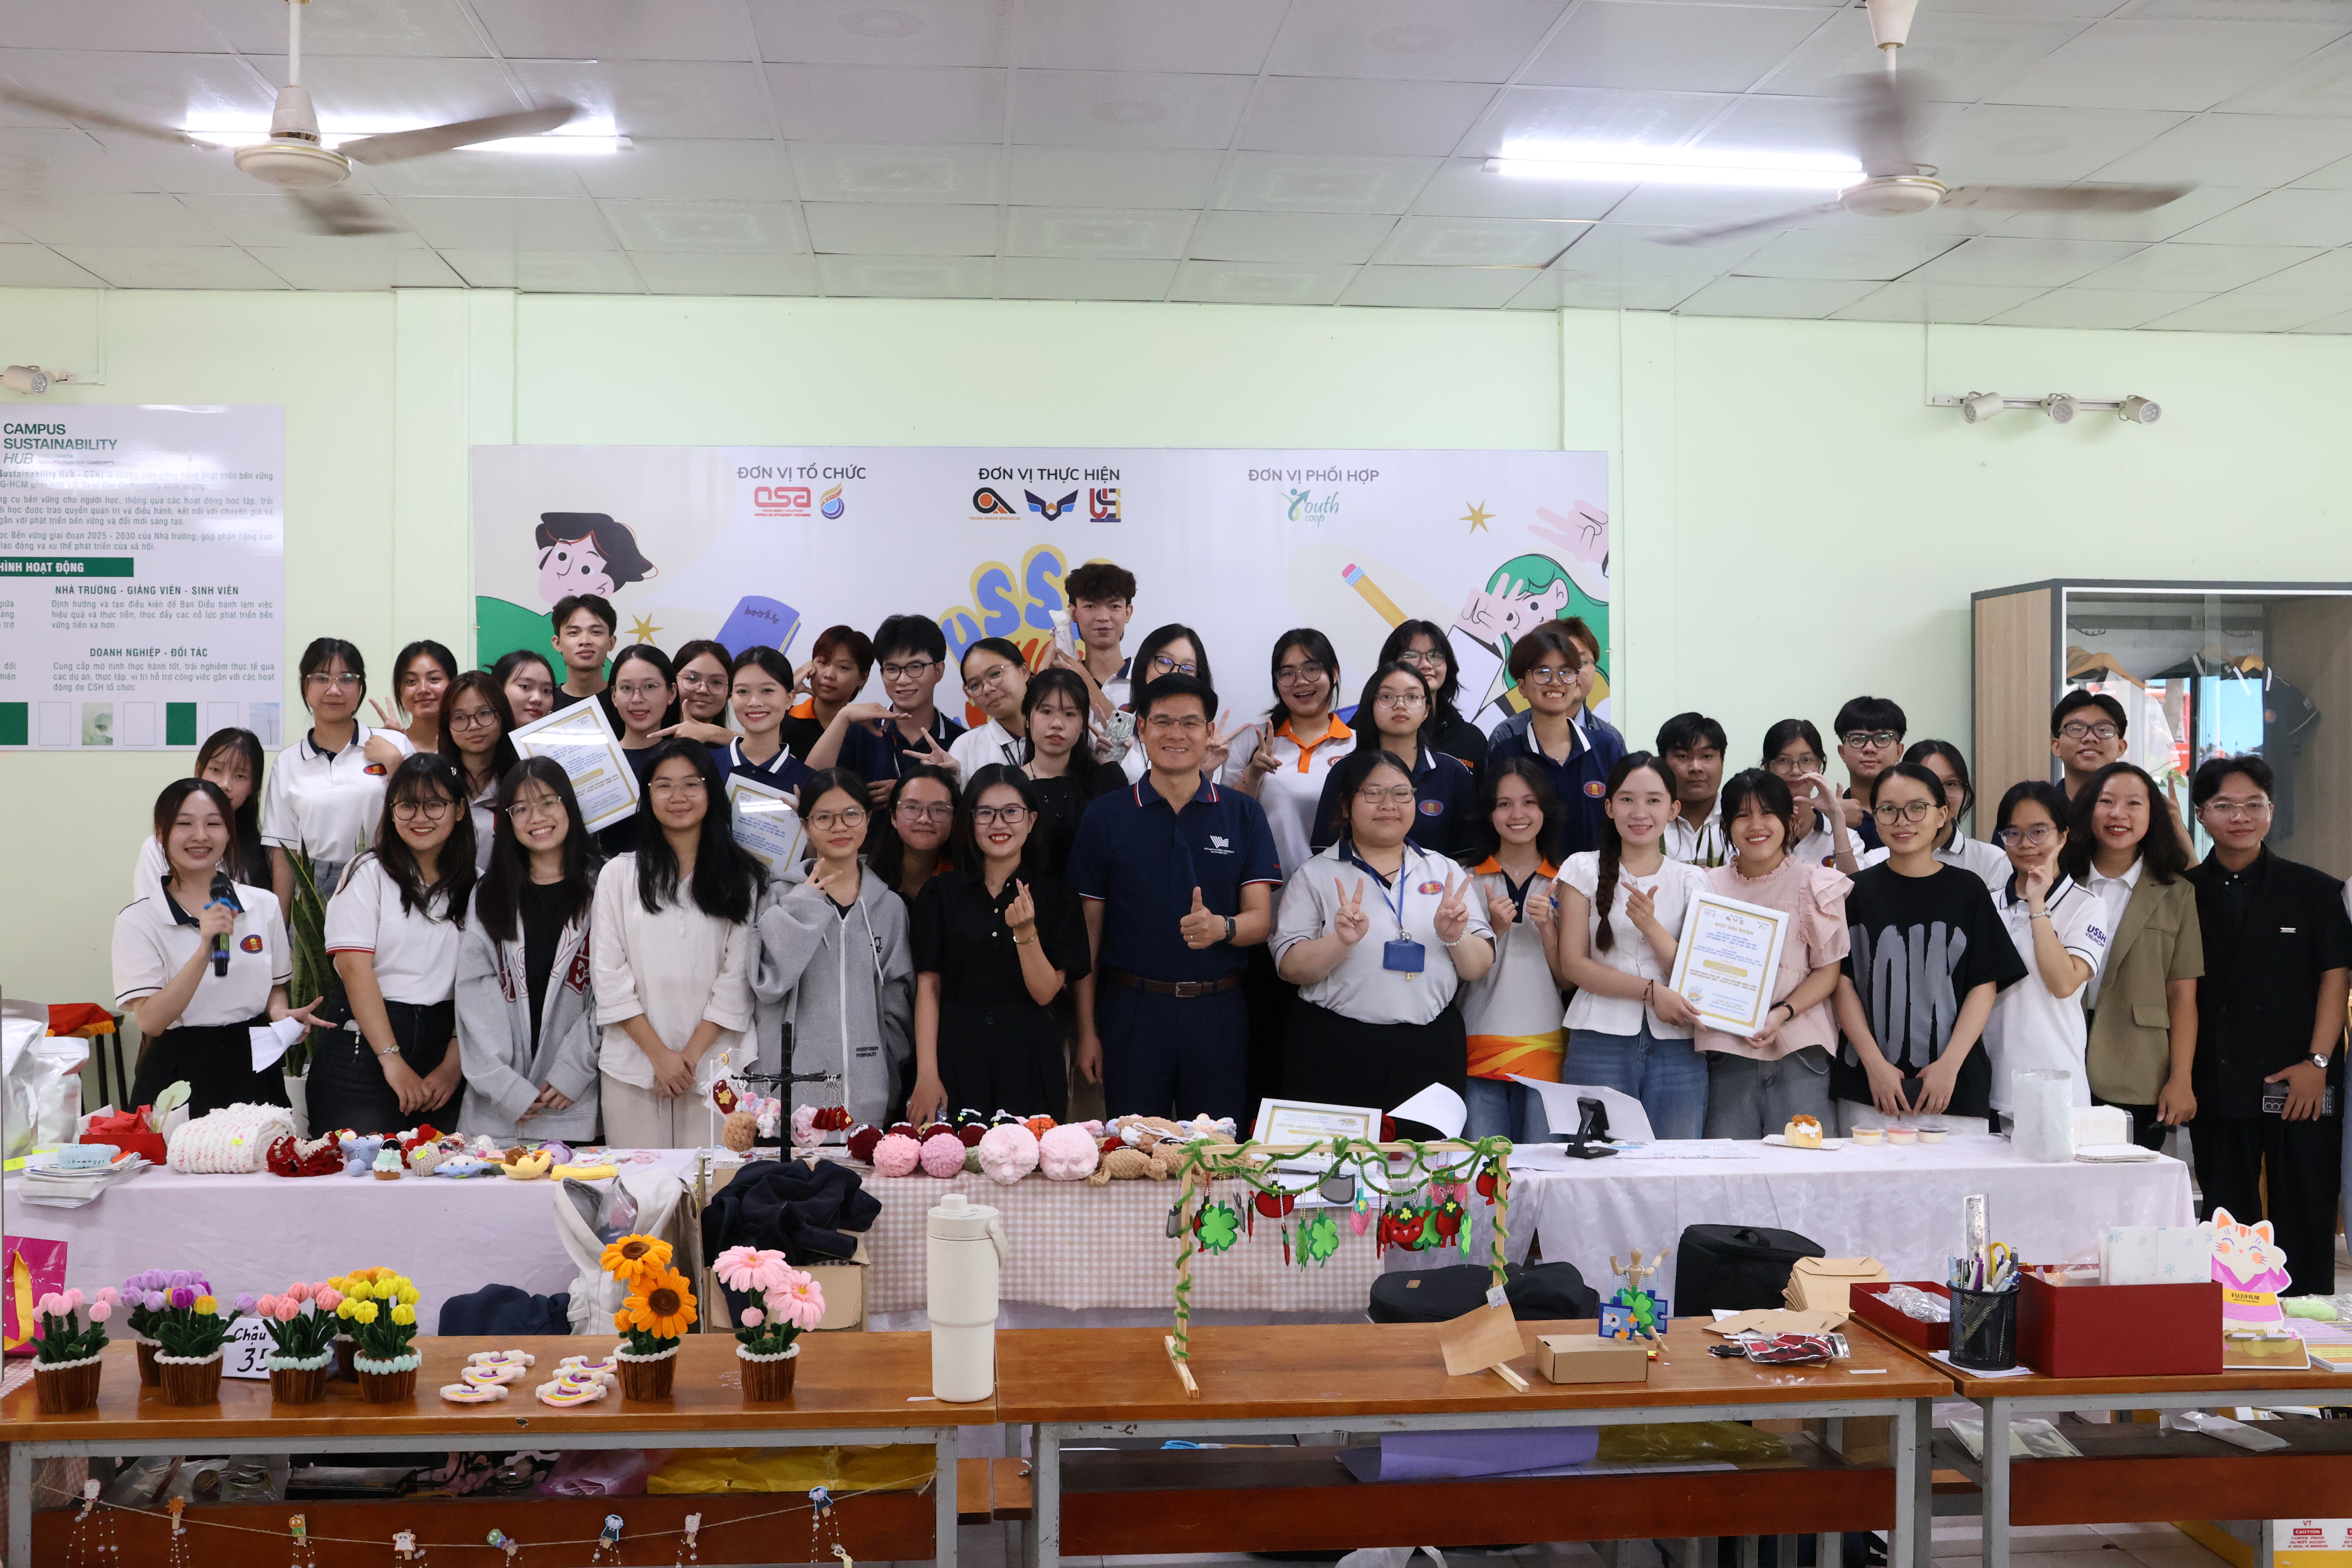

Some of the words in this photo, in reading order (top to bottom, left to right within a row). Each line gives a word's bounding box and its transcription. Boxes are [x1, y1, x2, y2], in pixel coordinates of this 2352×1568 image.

[3, 423, 66, 435] CAMPUS
[3, 438, 118, 450] SUSTAINABILITY
[3, 453, 34, 464] HUB
[737, 465, 772, 479] ĐƠN
[777, 467, 792, 482] VỊ
[796, 463, 818, 479] TỔ
[822, 464, 867, 479] CHỨC
[978, 466, 1013, 480] ĐƠN
[1017, 468, 1033, 483] VỊ
[1037, 467, 1080, 483] THỰC
[1084, 466, 1120, 483] HIỆN
[1248, 468, 1282, 481] ĐƠN
[1286, 470, 1301, 484] VỊ
[1306, 465, 1342, 481] PHỐI
[1347, 468, 1379, 485] HỢP
[1304, 513, 1325, 527] coop
[115, 532, 135, 540] 2030
[0, 559, 23, 572] HÌNH
[25, 562, 53, 575] HOẠT
[55, 560, 85, 575] ĐỘNG
[55, 584, 75, 595] NHÀ
[77, 584, 117, 595] TRƯỜNG
[127, 584, 156, 595] GIẢNG
[159, 584, 181, 595] VIÊN
[191, 586, 214, 595] SINH
[217, 584, 239, 595] VIÊN
[744, 605, 780, 624] books
[940, 551, 1083, 664] USS
[90, 648, 122, 657] DOANH
[125, 646, 161, 659] NGHIỆP
[170, 646, 187, 657] ĐỐI
[190, 646, 208, 657] TÁC
[87, 683, 104, 691] CSH
[2085, 933, 2104, 948] VNUHCM
[2087, 924, 2107, 943] USSH
[234, 1326, 267, 1345] Chậu
